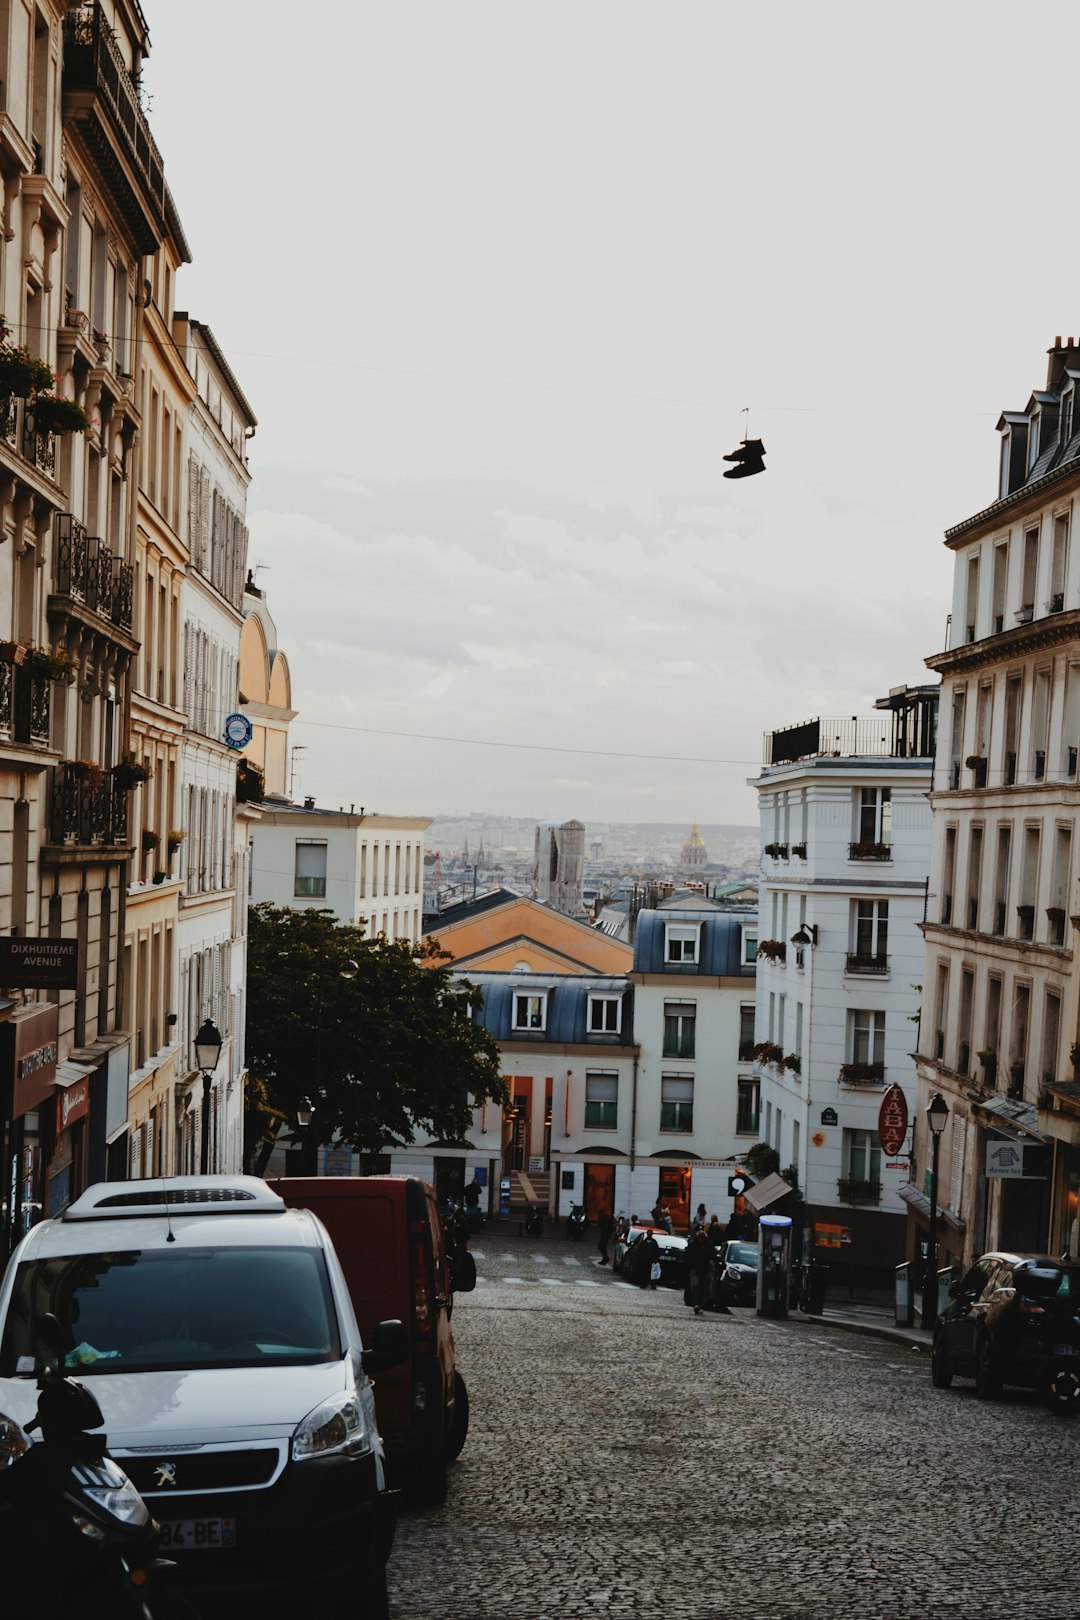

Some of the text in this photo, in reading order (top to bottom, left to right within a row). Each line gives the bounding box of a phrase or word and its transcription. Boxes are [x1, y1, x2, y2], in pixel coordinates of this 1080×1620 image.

[11, 944, 74, 955] DIXHUITIEME
[23, 957, 62, 967] AVENUE
[884, 1088, 903, 1155] TABAC
[897, 1272, 906, 1281] 01
[939, 1278, 949, 1286] 02
